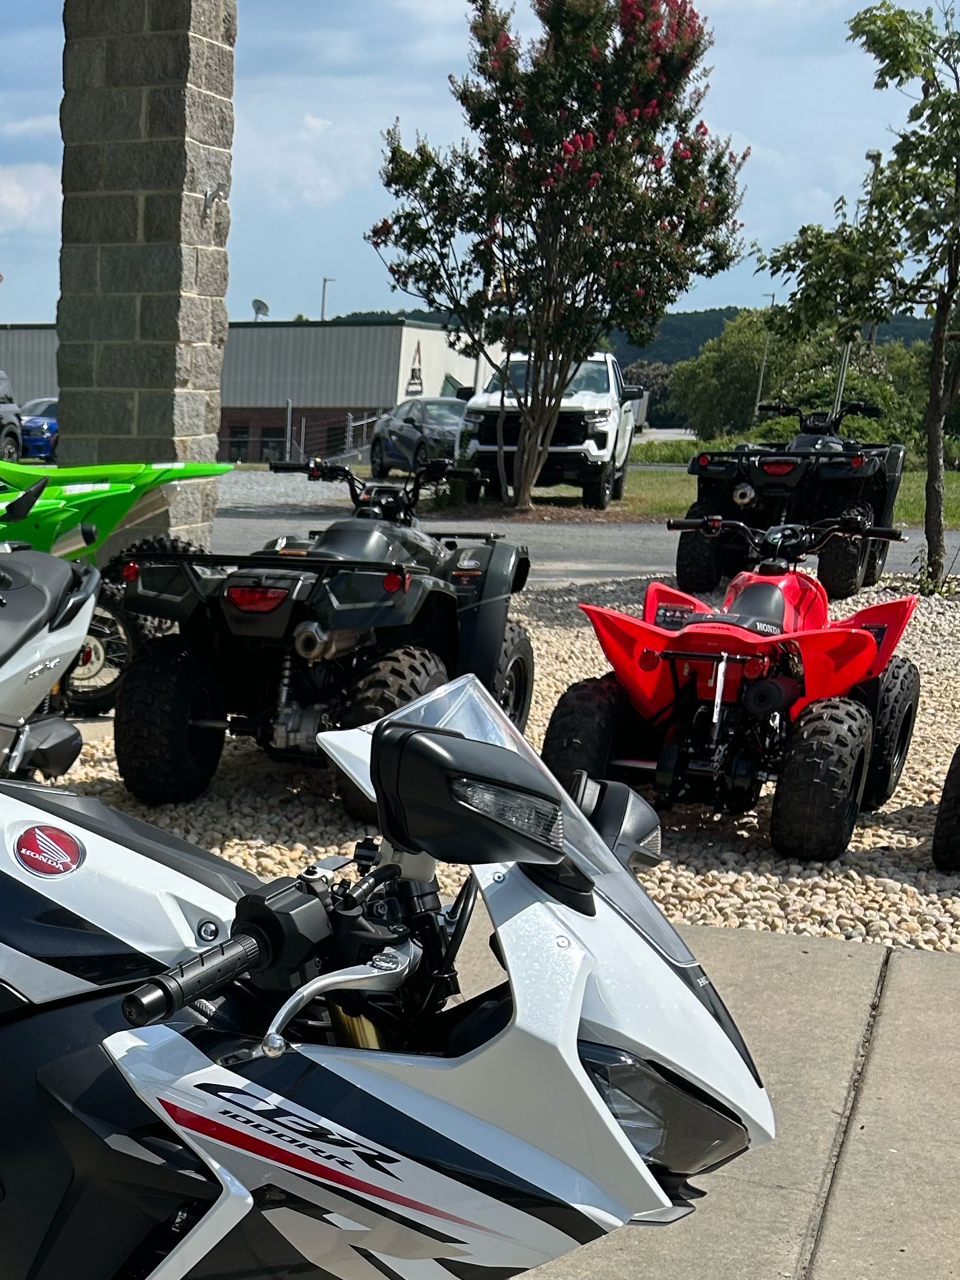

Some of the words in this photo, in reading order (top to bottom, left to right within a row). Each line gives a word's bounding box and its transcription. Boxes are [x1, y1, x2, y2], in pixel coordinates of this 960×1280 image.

[20, 847, 64, 871] HONDA
[193, 1083, 404, 1183] CBR
[218, 1109, 355, 1172] 1000RR
